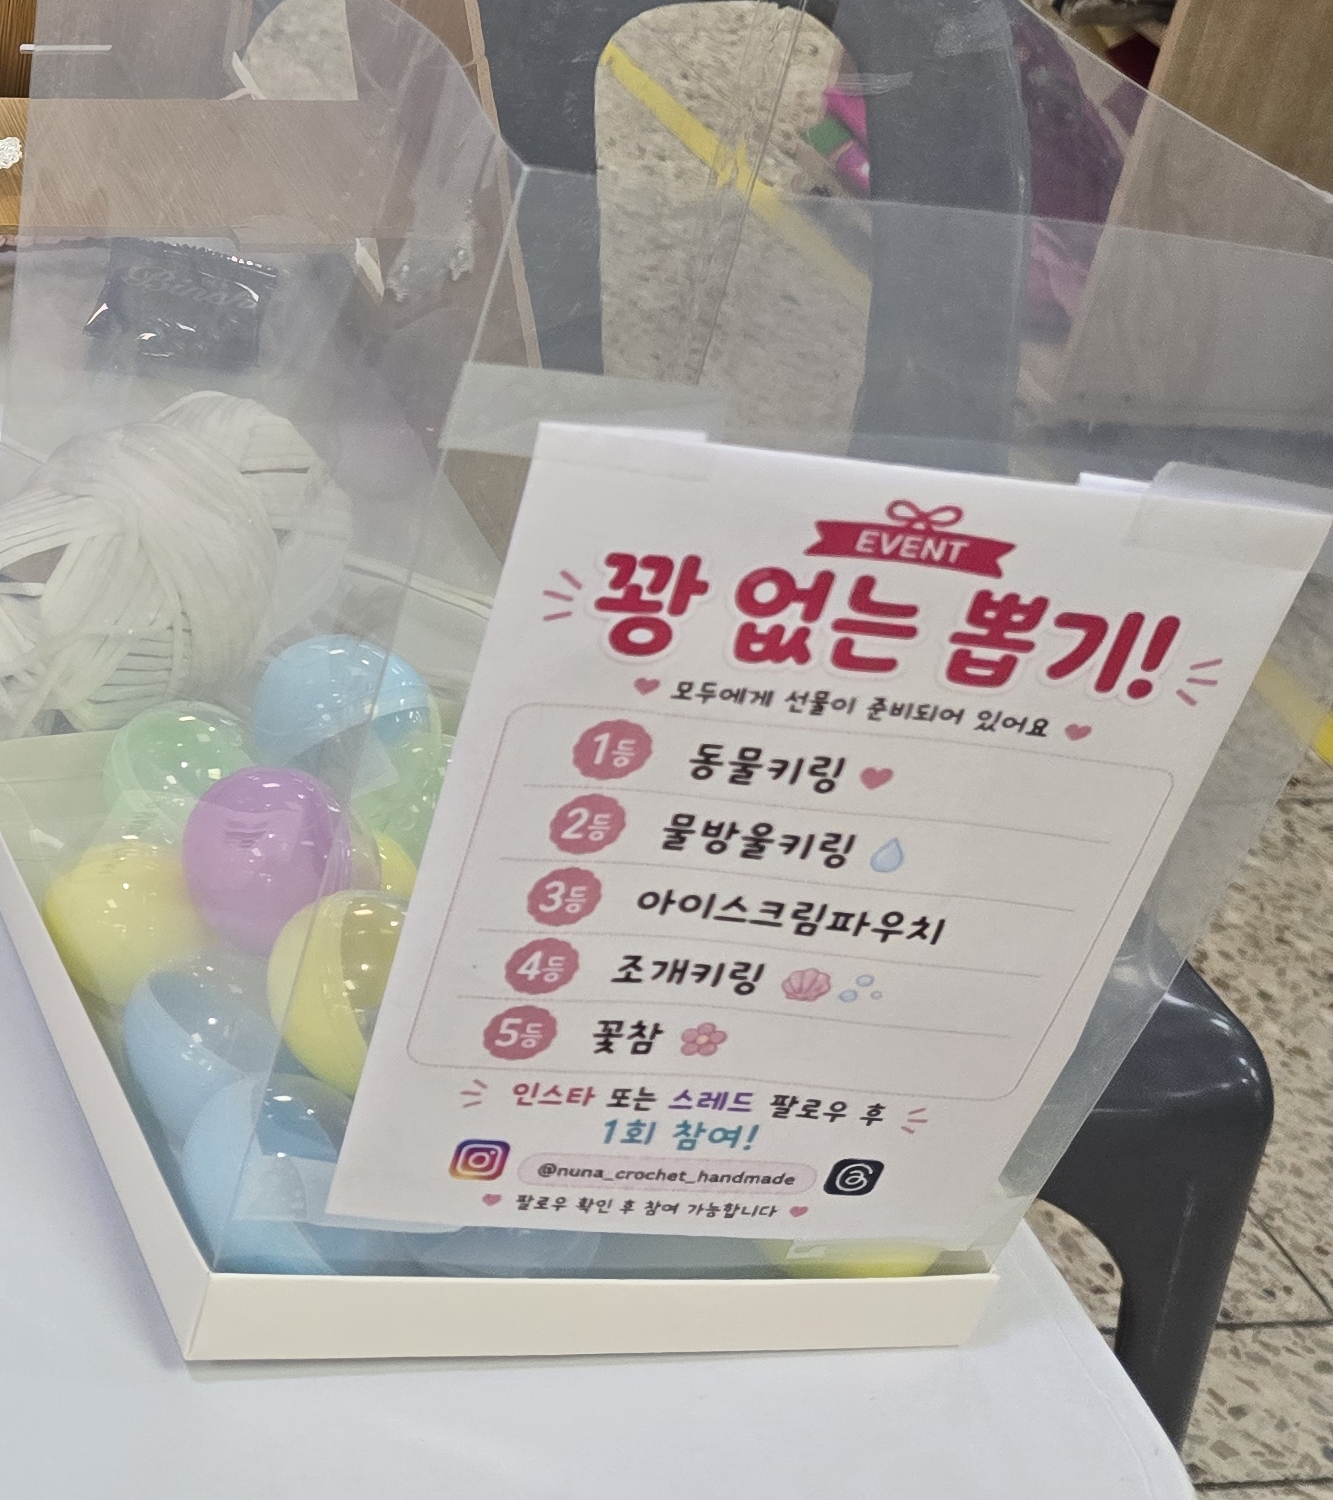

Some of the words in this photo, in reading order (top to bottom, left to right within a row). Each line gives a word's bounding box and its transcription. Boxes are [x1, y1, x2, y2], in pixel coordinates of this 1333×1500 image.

[854, 529, 970, 564] EVENT
[594, 553, 709, 657] 꽝
[733, 566, 920, 673] 없는
[946, 588, 1181, 699] 뽑기!
[670, 680, 775, 708] 모두에게
[784, 689, 857, 717] 선물이
[866, 697, 965, 725] 준비되어
[973, 710, 1050, 738] 있어요
[592, 732, 636, 769] 1등
[688, 743, 848, 795] 동물키링
[560, 807, 612, 841] 2등
[661, 812, 858, 869] 물방울키링
[538, 880, 588, 915] 3등
[636, 890, 946, 946] 아이스크림파우치
[516, 951, 565, 983] 4등
[610, 955, 766, 996] 조개키링
[494, 1018, 543, 1049] 5등
[592, 1020, 664, 1056] 꽃참
[512, 1082, 596, 1108] 인스타
[606, 1086, 659, 1111] 또는
[667, 1088, 754, 1113] 스레드
[770, 1093, 849, 1121] 팔로우
[859, 1103, 887, 1127] 후
[602, 1118, 657, 1146] 1회
[672, 1120, 760, 1151] 참여!
[538, 1162, 796, 1187] @nuna_crochet_handmade
[516, 1194, 568, 1211] 팔로우
[576, 1196, 613, 1214] 확인
[619, 1199, 636, 1215] 후
[644, 1200, 680, 1217] 참여
[687, 1202, 778, 1219] 가능합니다
